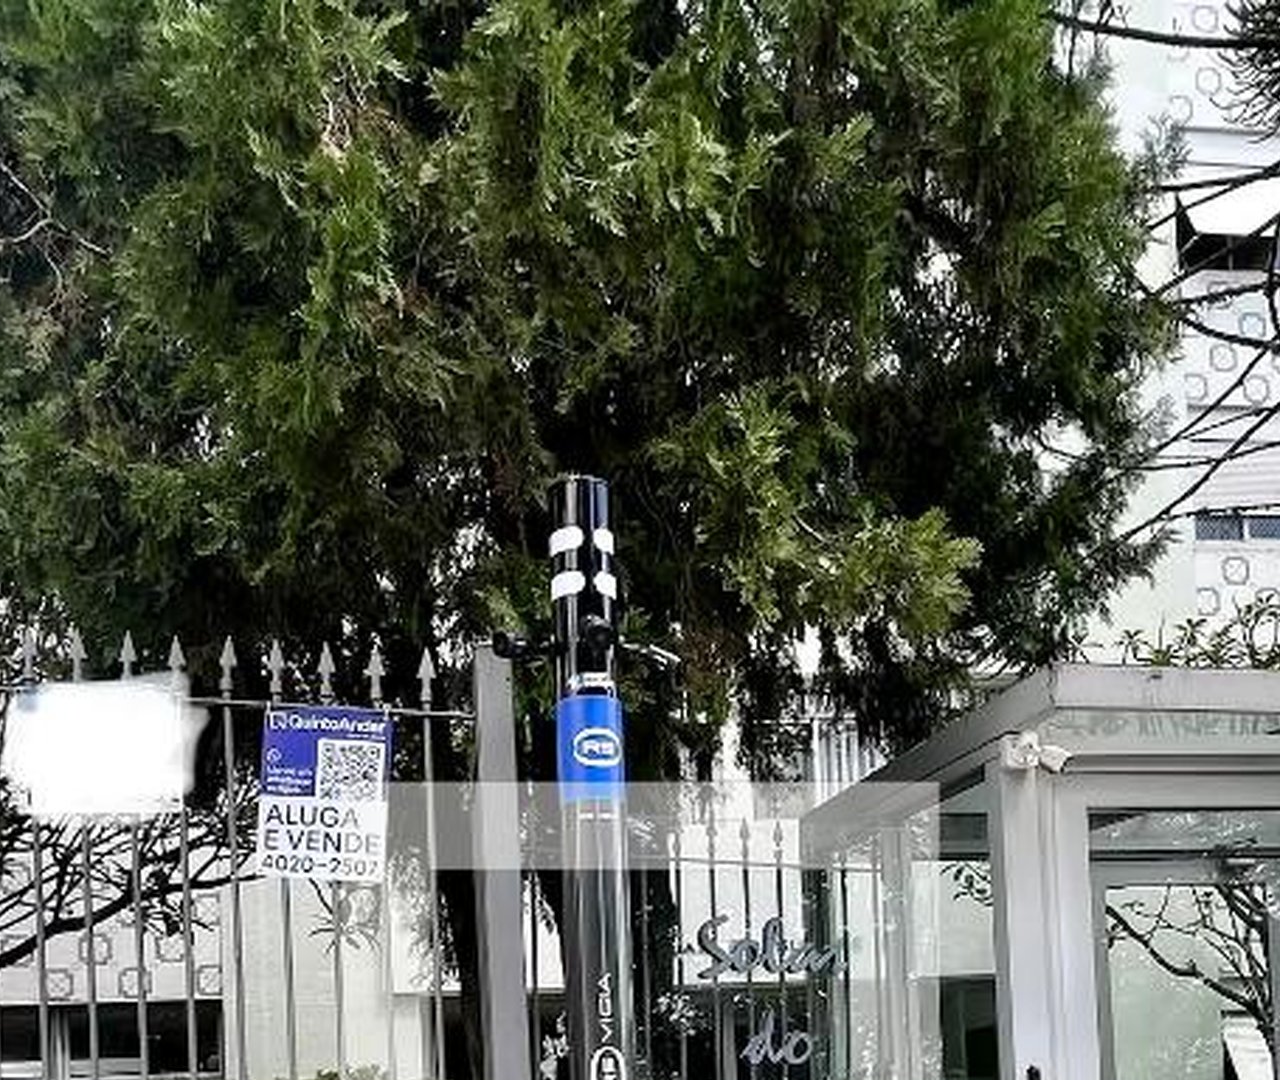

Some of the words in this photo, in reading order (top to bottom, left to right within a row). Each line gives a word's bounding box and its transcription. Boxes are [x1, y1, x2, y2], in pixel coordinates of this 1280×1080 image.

[265, 804, 359, 828] ALUGA
[264, 829, 279, 850] E
[286, 829, 381, 855] VENDE
